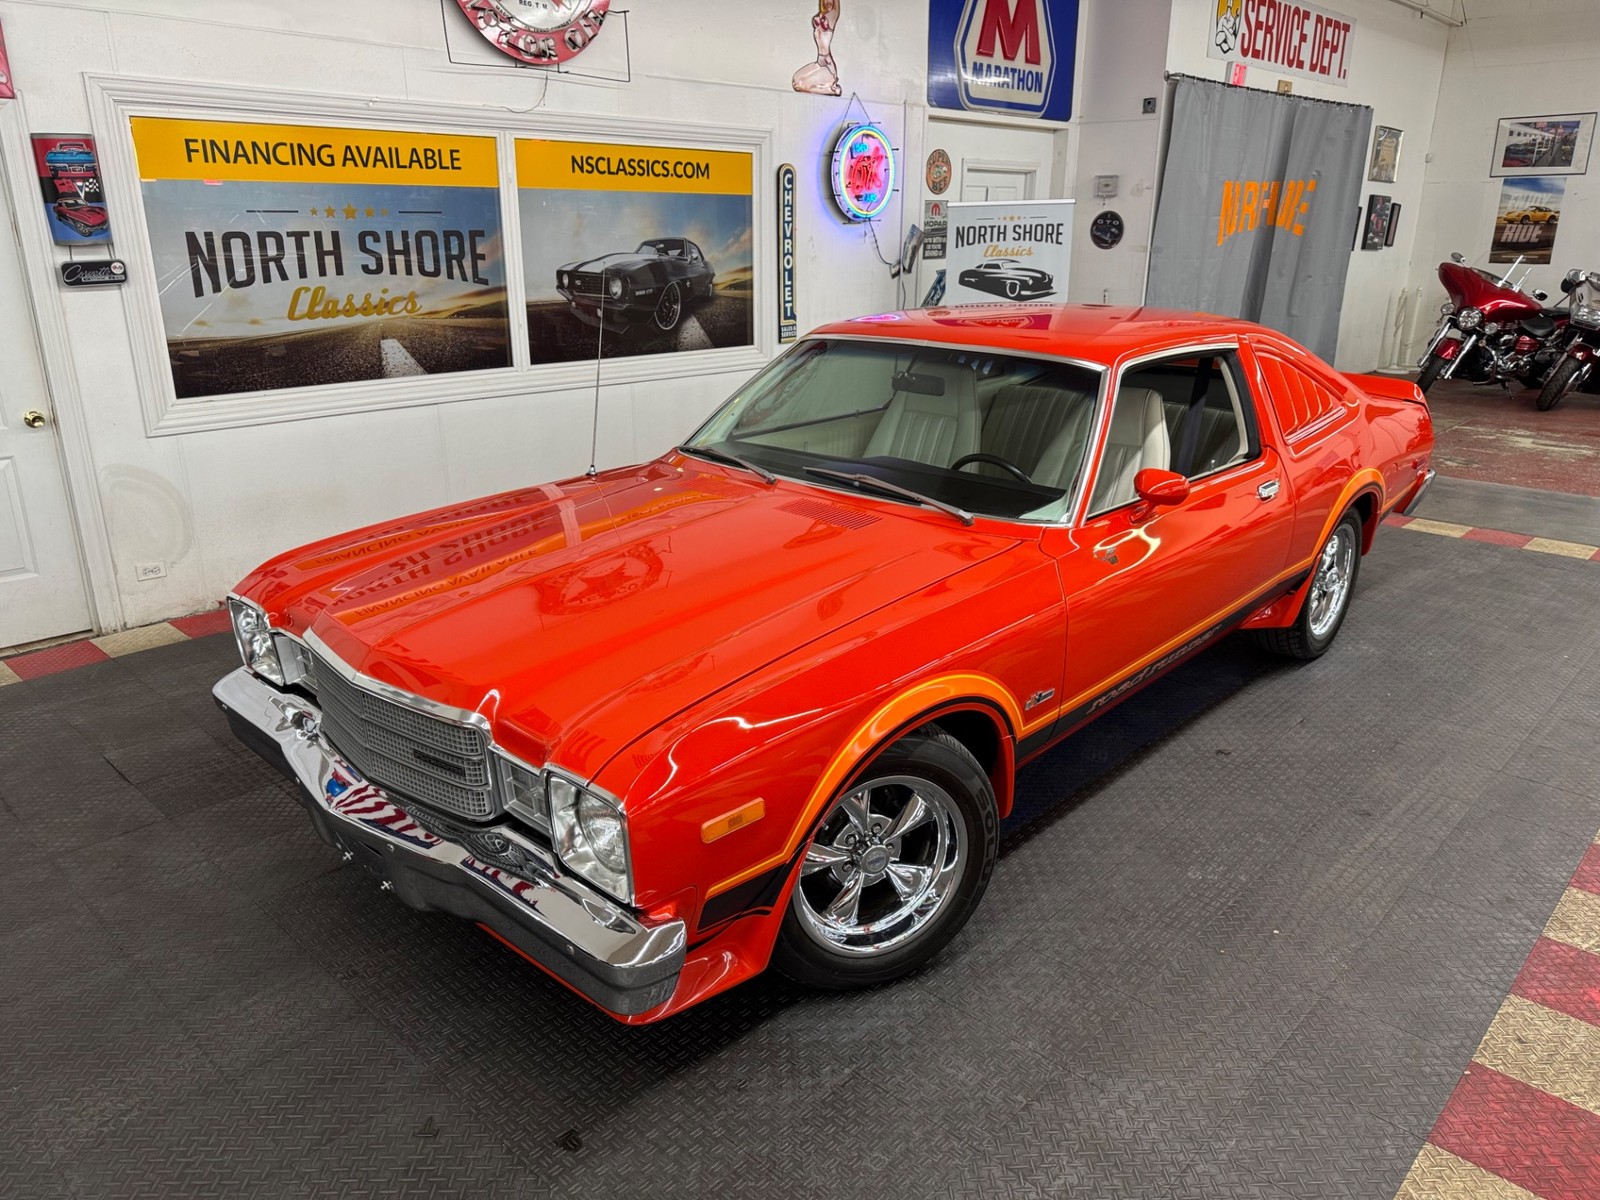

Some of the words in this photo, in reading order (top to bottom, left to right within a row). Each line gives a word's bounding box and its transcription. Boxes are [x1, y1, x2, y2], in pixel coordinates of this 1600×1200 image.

[1240, 0, 1311, 69] SERVICE
[1309, 14, 1351, 80] DEPT.
[972, 61, 1043, 93] MARATHON
[184, 138, 336, 168] FINANCING
[341, 145, 462, 171] AVAILABLE
[571, 155, 710, 180] NSCLASSICS.COM
[783, 173, 794, 318] CHEVROLET
[955, 225, 1007, 249] NORTH
[1012, 223, 1064, 245] SHORE
[1500, 223, 1543, 243] RIDE
[185, 230, 344, 298] NORTH
[358, 229, 489, 286] SHORE
[983, 244, 1034, 257] Classics
[287, 285, 423, 322] Classics
